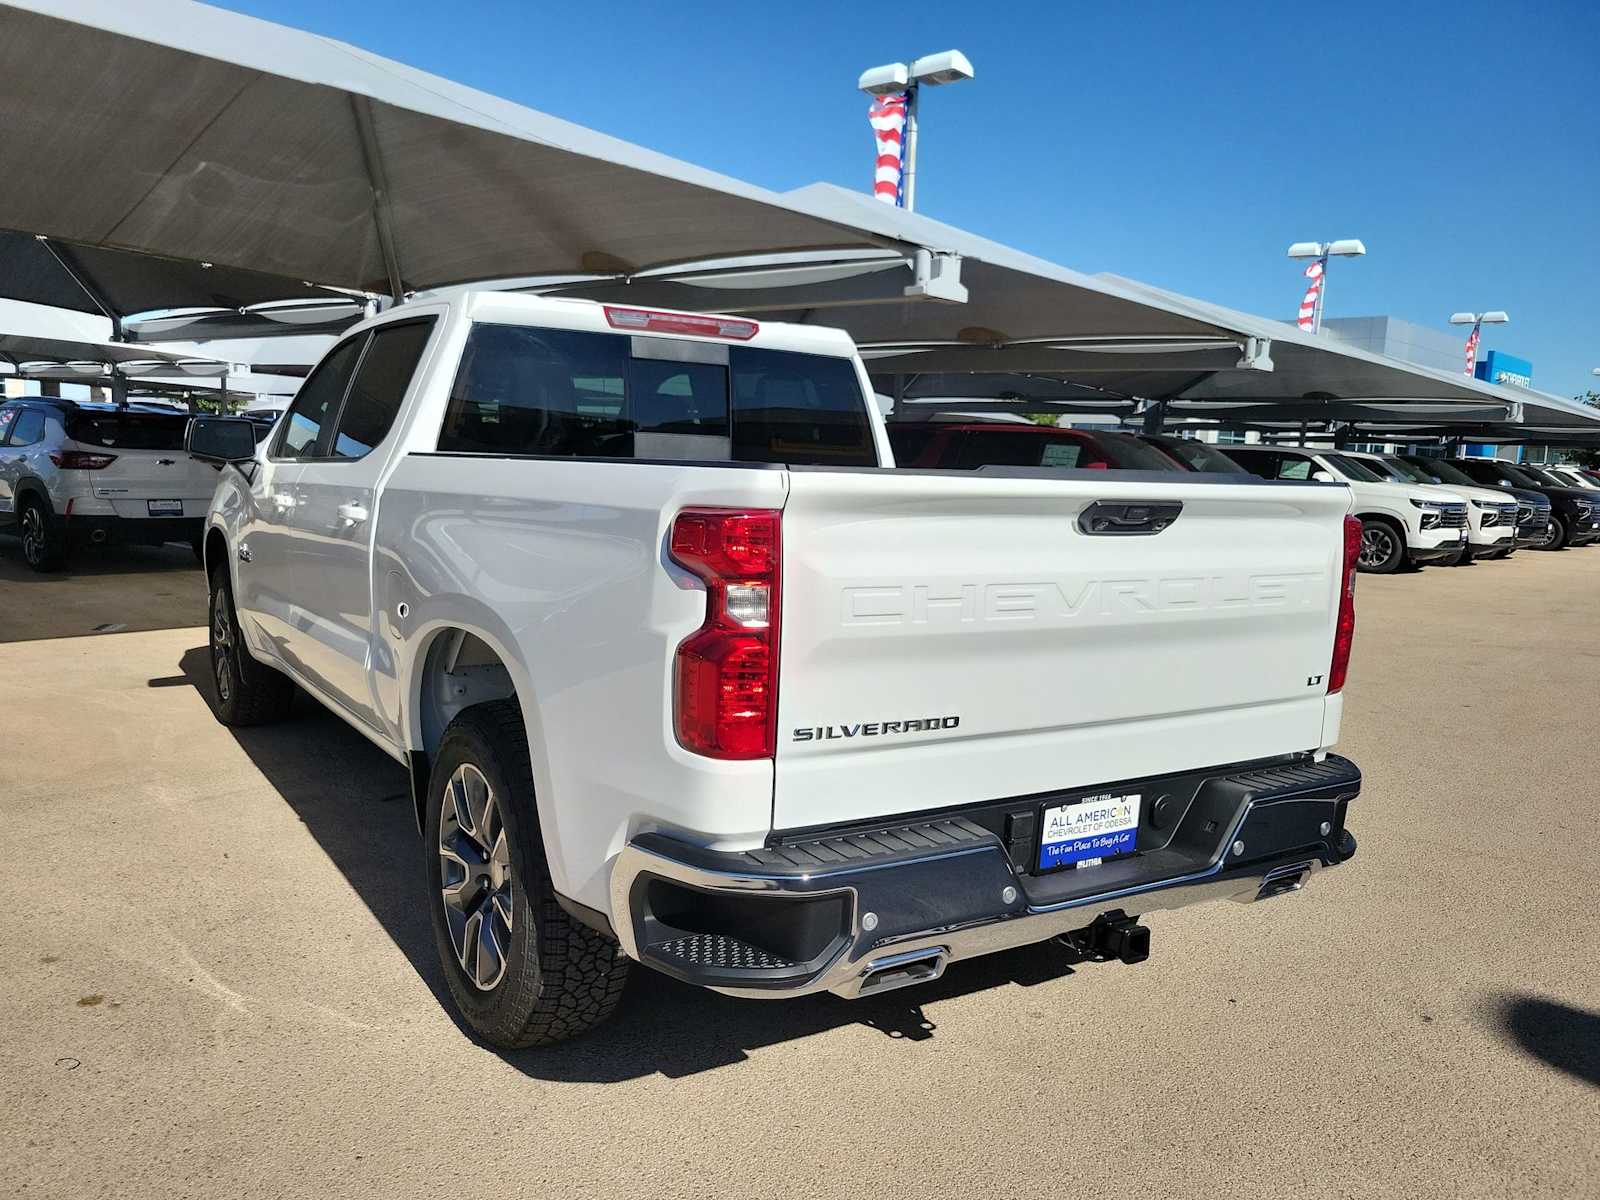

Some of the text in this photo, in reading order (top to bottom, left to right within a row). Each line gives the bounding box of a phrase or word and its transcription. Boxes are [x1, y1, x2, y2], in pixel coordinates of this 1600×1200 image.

[1307, 674, 1324, 686] LT
[793, 716, 960, 742] SILVERADO
[1047, 817, 1132, 838] CHEVROLET OF ODESSA
[1050, 815, 1072, 828] ALL
[1047, 845, 1060, 856] The
[1060, 844, 1073, 854] Fun
[1073, 842, 1091, 852] Place
[1092, 839, 1100, 848] To
[1100, 836, 1113, 848] Buy
[1112, 835, 1119, 843] A
